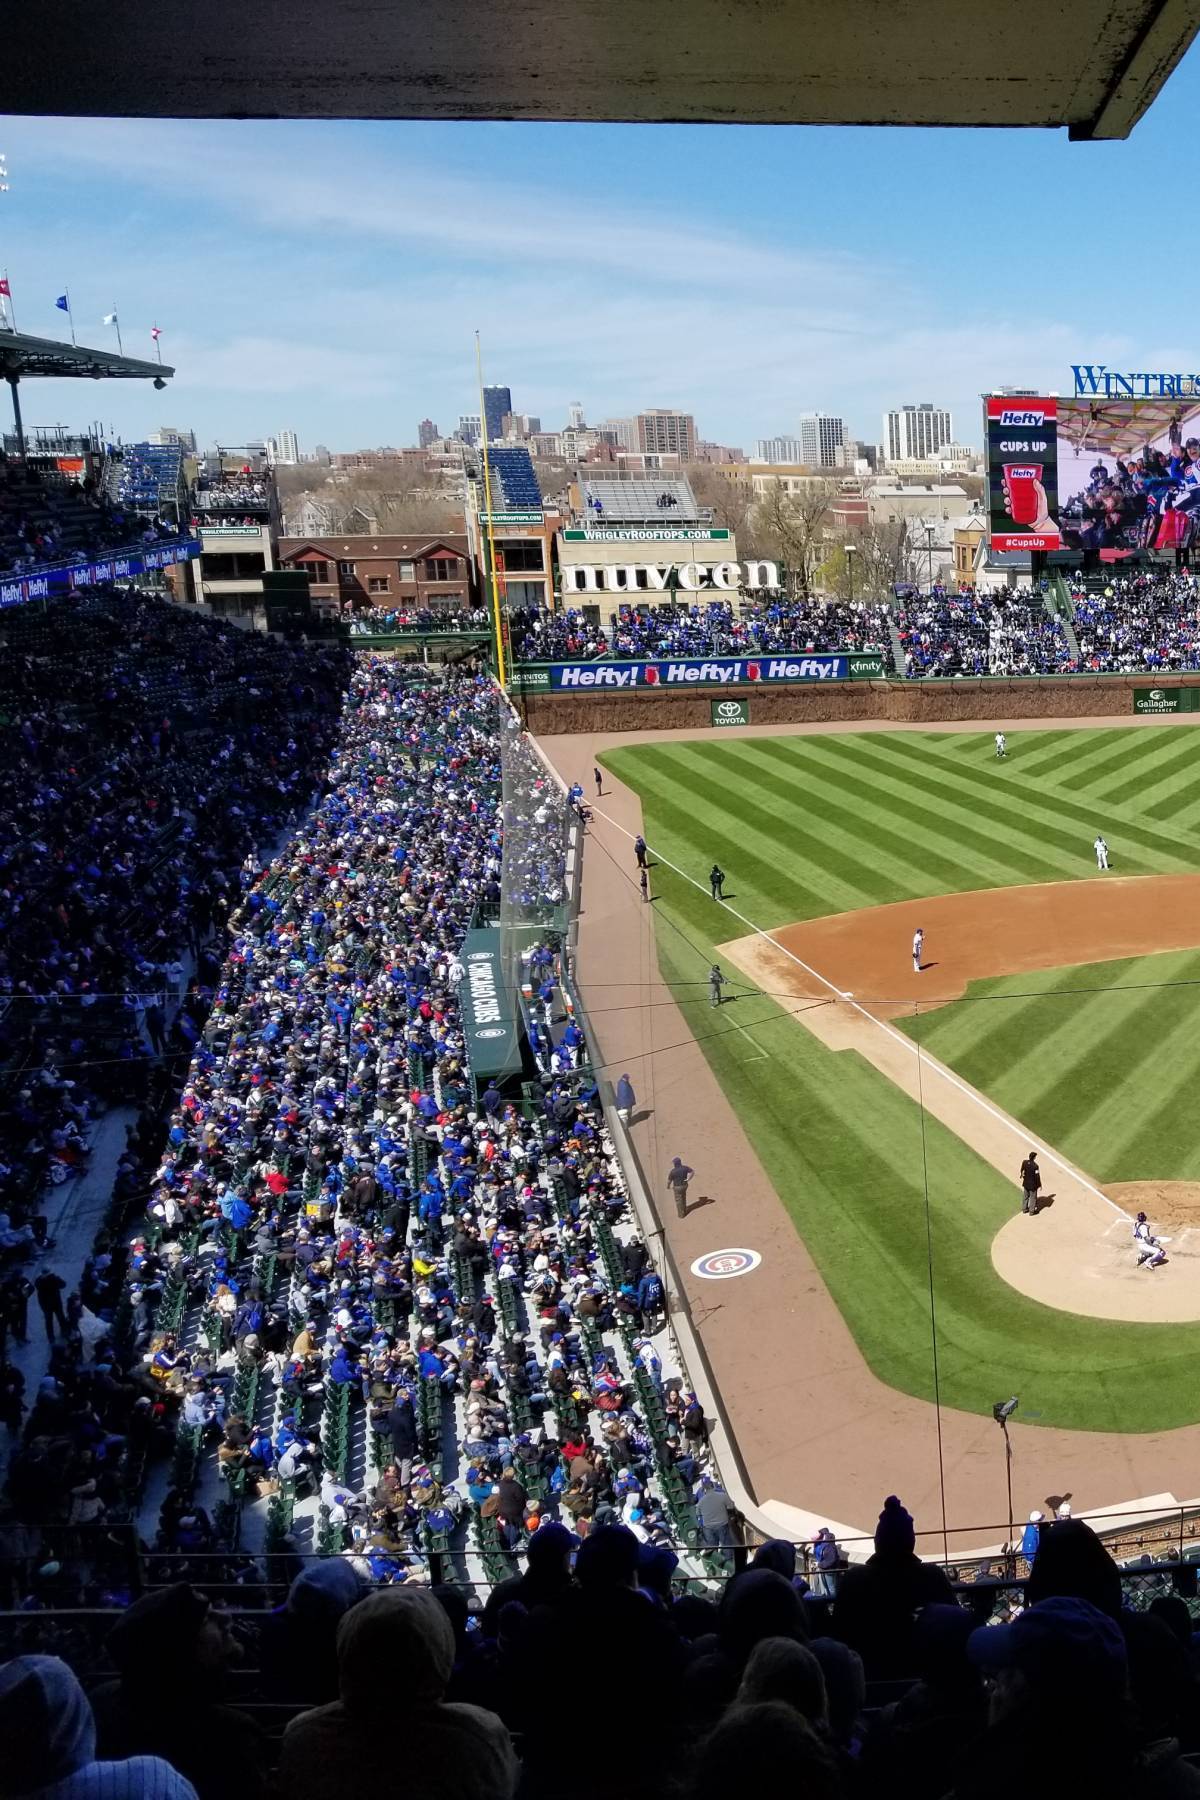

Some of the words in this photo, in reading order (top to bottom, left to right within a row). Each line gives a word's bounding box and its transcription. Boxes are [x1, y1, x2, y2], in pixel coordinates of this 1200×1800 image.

[1003, 412, 1042, 424] Hefty
[1000, 442, 1029, 452] CUPS
[1032, 442, 1047, 452] UP
[584, 530, 712, 540] WRIGLEYROOFTOPS.COM
[1006, 538, 1045, 547] #CupsUp
[561, 560, 782, 592] nuveen
[1, 583, 23, 602] Hefty!
[28, 578, 48, 596] Hefty!
[74, 568, 91, 585] Hefty!
[561, 666, 638, 687] Hefty!
[667, 662, 742, 683] Hefty!
[768, 658, 840, 679] Hefty!
[850, 661, 882, 673] xfinity
[1136, 700, 1178, 708] Gallagher
[468, 962, 496, 998] CHICAGO
[472, 998, 501, 1024] CUBS
